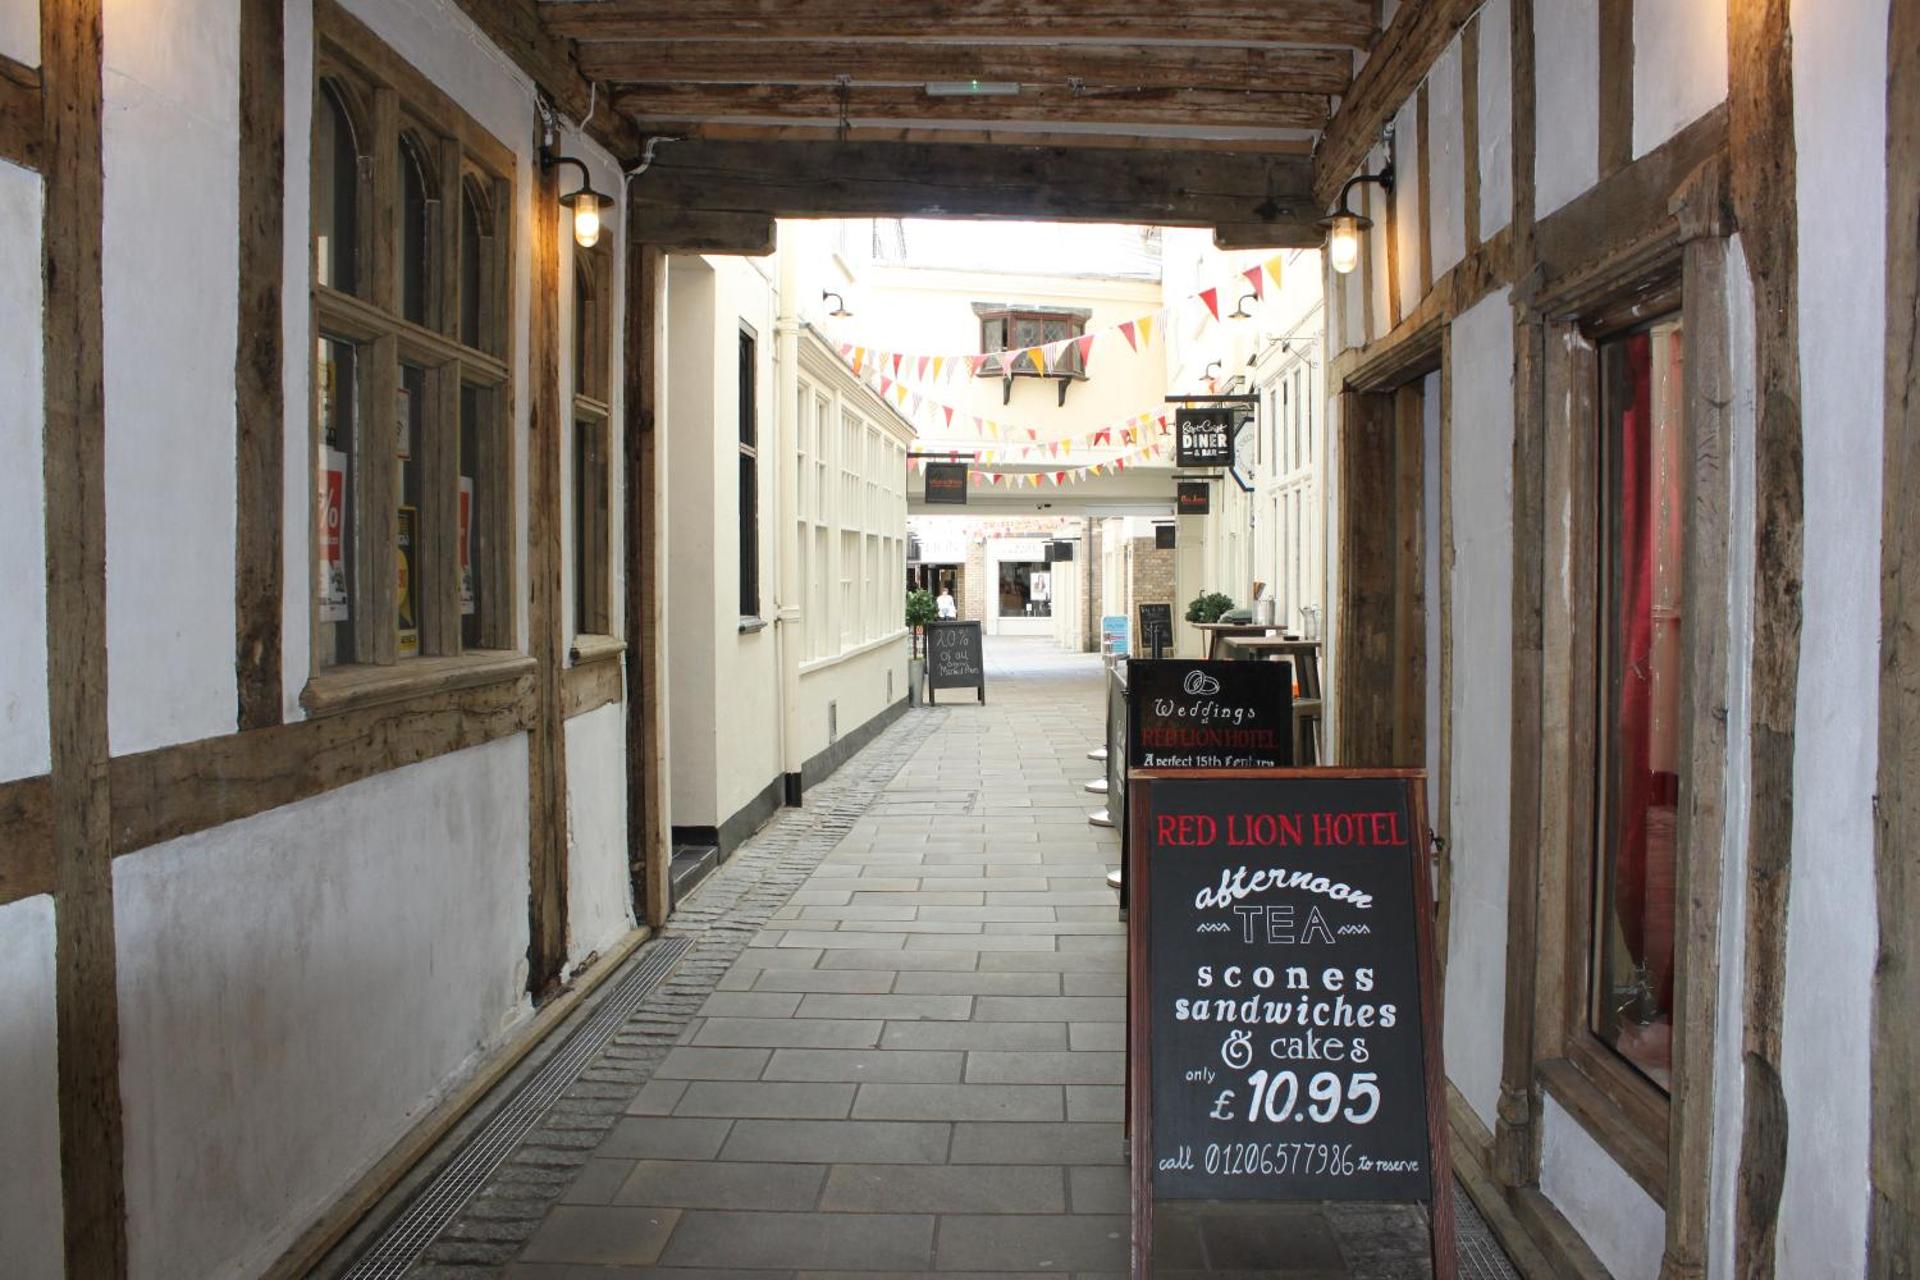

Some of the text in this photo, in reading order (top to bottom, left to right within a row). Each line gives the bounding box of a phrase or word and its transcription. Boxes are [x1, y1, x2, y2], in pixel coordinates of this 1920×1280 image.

[1182, 433, 1228, 448] DINER
[1202, 448, 1218, 457] BAR
[1155, 698, 1256, 725] Weddings
[1142, 727, 1279, 749] RED LION HOTEL
[1143, 753, 1154, 767] A
[1156, 754, 1192, 767] perfect
[1196, 755, 1222, 767] 15th
[1157, 812, 1408, 847] RED LION HOTEL
[1195, 865, 1373, 910] afternoon
[1233, 905, 1336, 945] TEA
[1197, 965, 1375, 992] scones
[1175, 994, 1398, 1028] sandwiches
[1221, 1028, 1370, 1069] & cakes
[1185, 1067, 1216, 1086] only
[1247, 1069, 1382, 1125] 10.95
[1159, 1143, 1420, 1177] call 01206577986 to reserve
